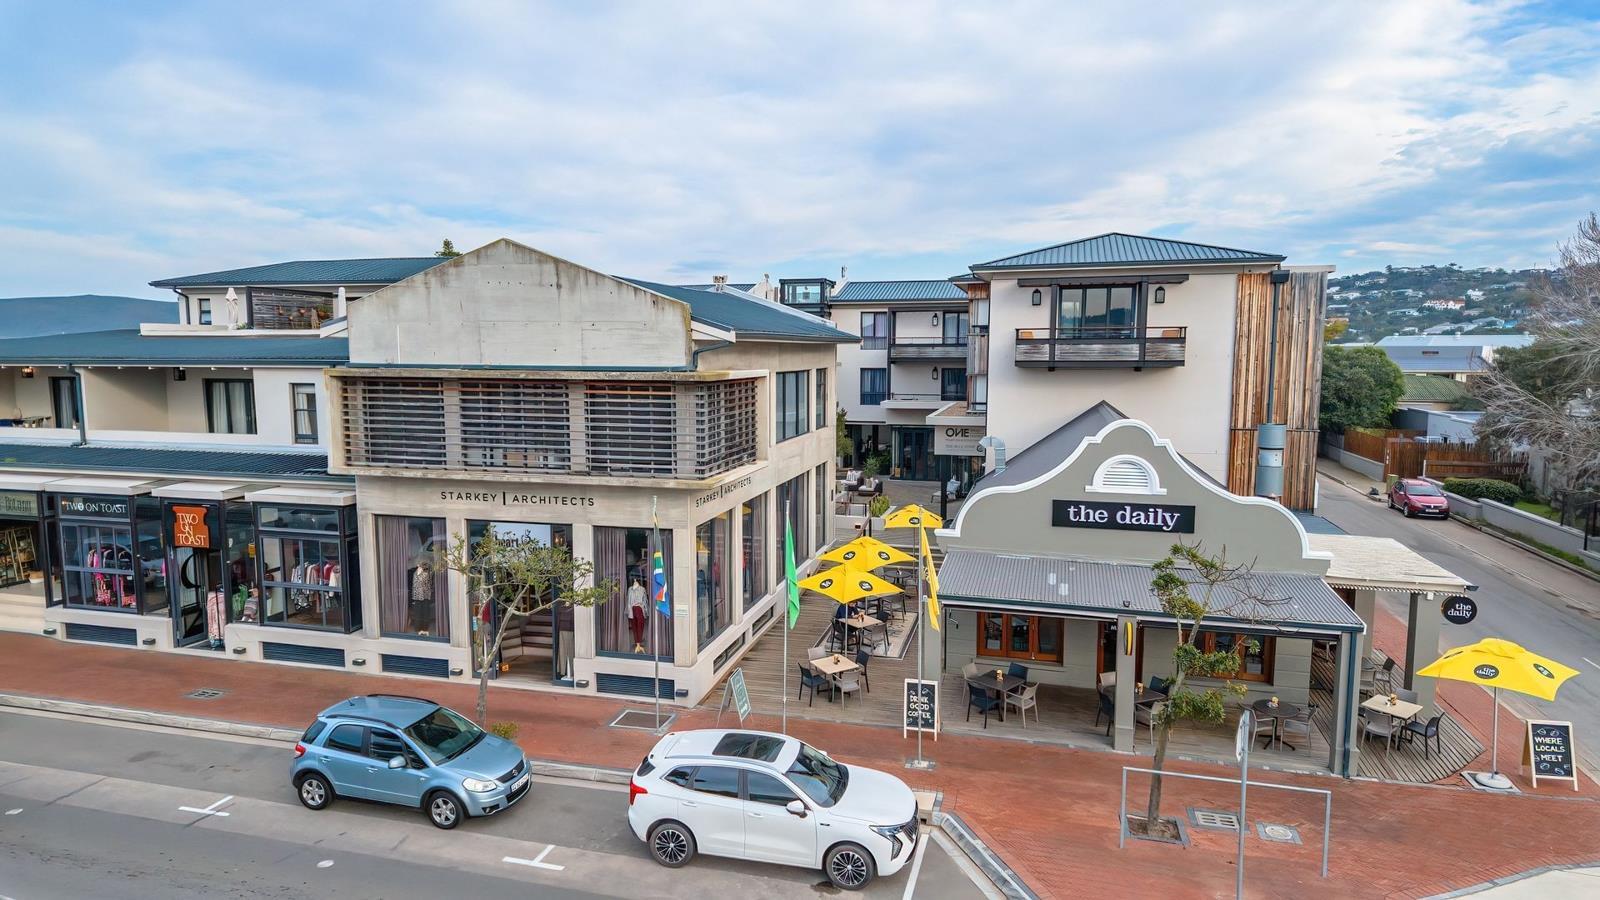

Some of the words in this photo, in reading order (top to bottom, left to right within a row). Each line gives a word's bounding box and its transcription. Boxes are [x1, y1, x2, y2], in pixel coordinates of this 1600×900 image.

[945, 427, 970, 438] ONE
[695, 491, 719, 508] STARKEY
[724, 476, 751, 494] ARCHITECTS
[440, 491, 497, 502] STARKEY
[512, 494, 595, 506] ARCHITECTS
[65, 501, 84, 511] TWO
[85, 502, 99, 512] ON
[100, 503, 127, 513] TOAST
[176, 513, 199, 524] TWO
[1067, 505, 1109, 523] the
[1115, 505, 1180, 531] daily
[177, 534, 206, 546] TOAST
[1455, 603, 1472, 611] the
[1447, 608, 1472, 619] daily
[909, 703, 930, 711] GOOD
[1534, 736, 1563, 745] WHERE
[1535, 745, 1566, 753] LOCALS
[1540, 754, 1563, 762] MEET
